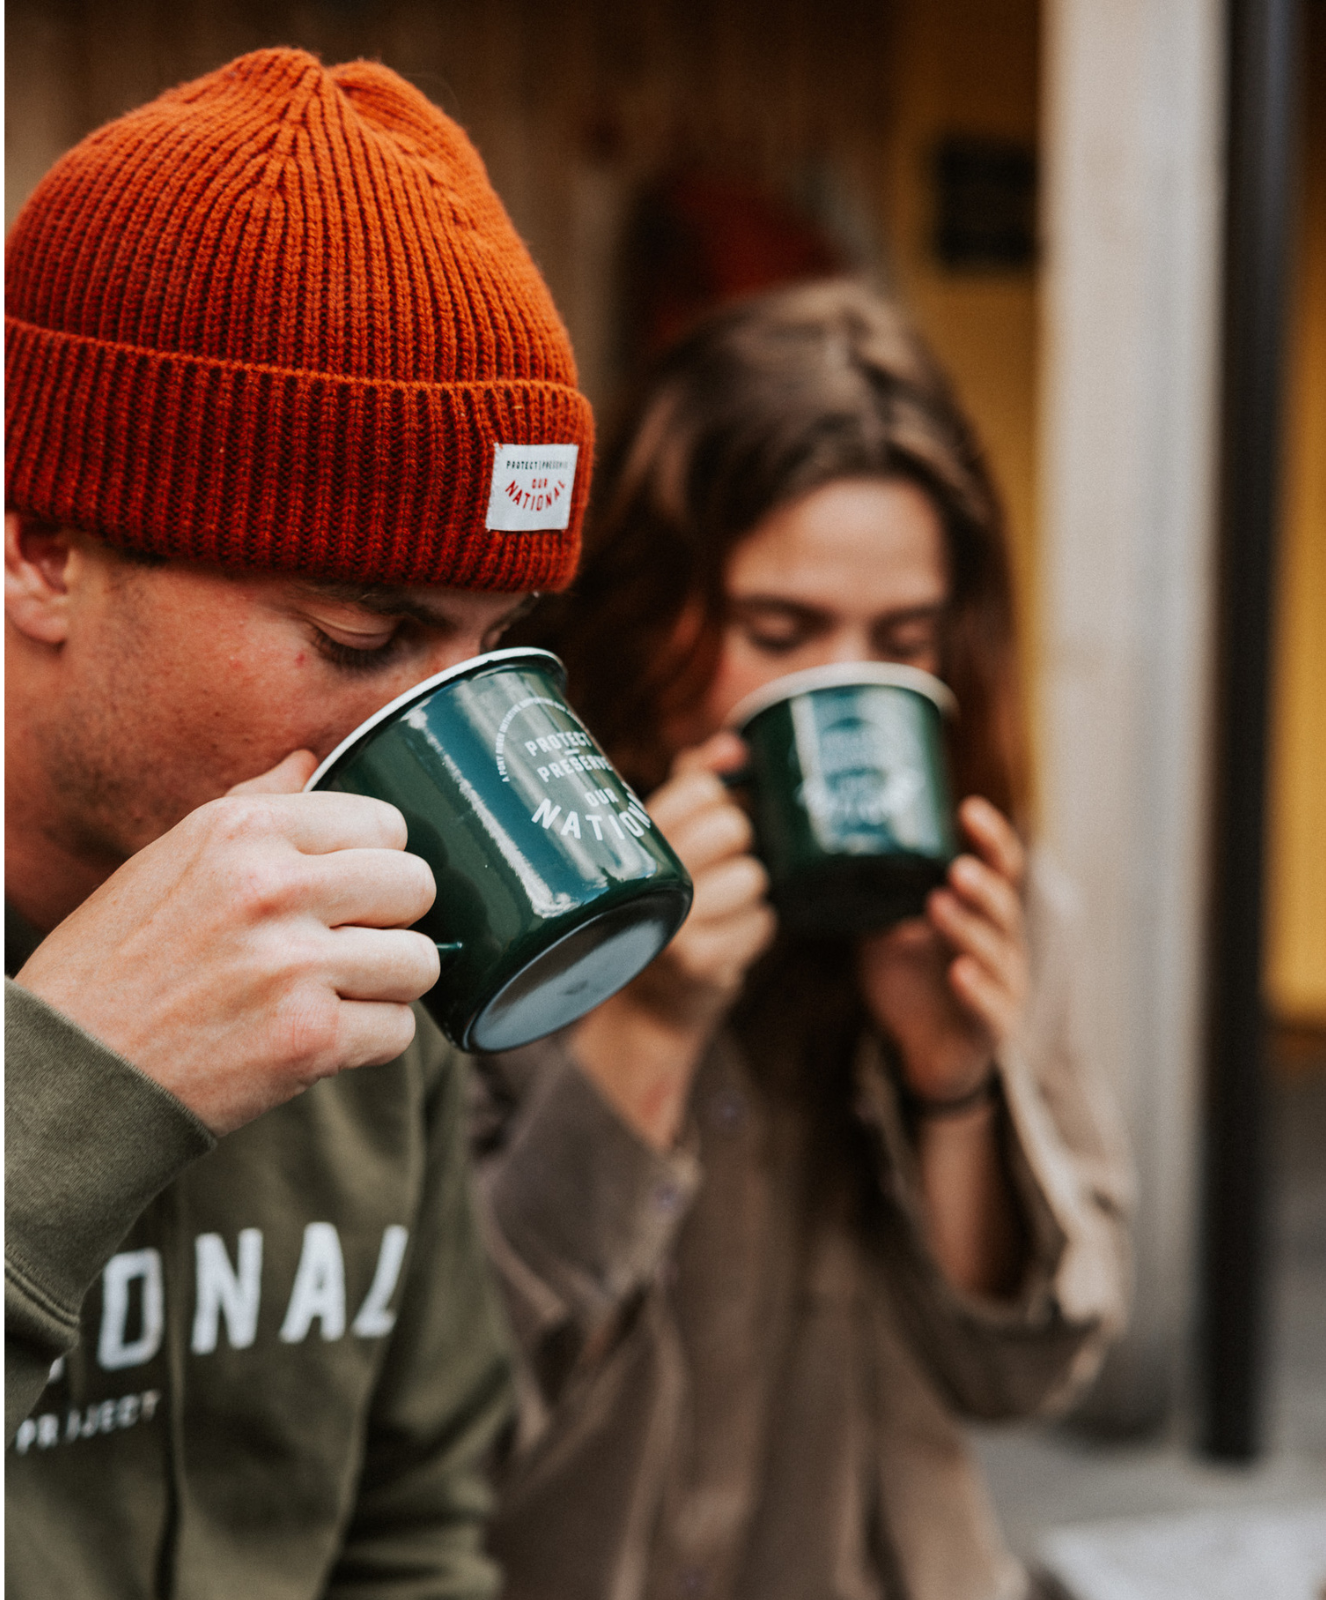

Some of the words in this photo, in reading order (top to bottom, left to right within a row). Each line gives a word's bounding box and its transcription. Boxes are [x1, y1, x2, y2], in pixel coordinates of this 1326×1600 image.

[506, 460, 538, 470] PROTECT
[505, 480, 566, 511] NATIONAL
[532, 478, 548, 489] OUR
[524, 731, 593, 757] PROTECT
[584, 787, 619, 807] OUR
[531, 781, 651, 840] NATION
[48, 1221, 409, 1384] ONAL
